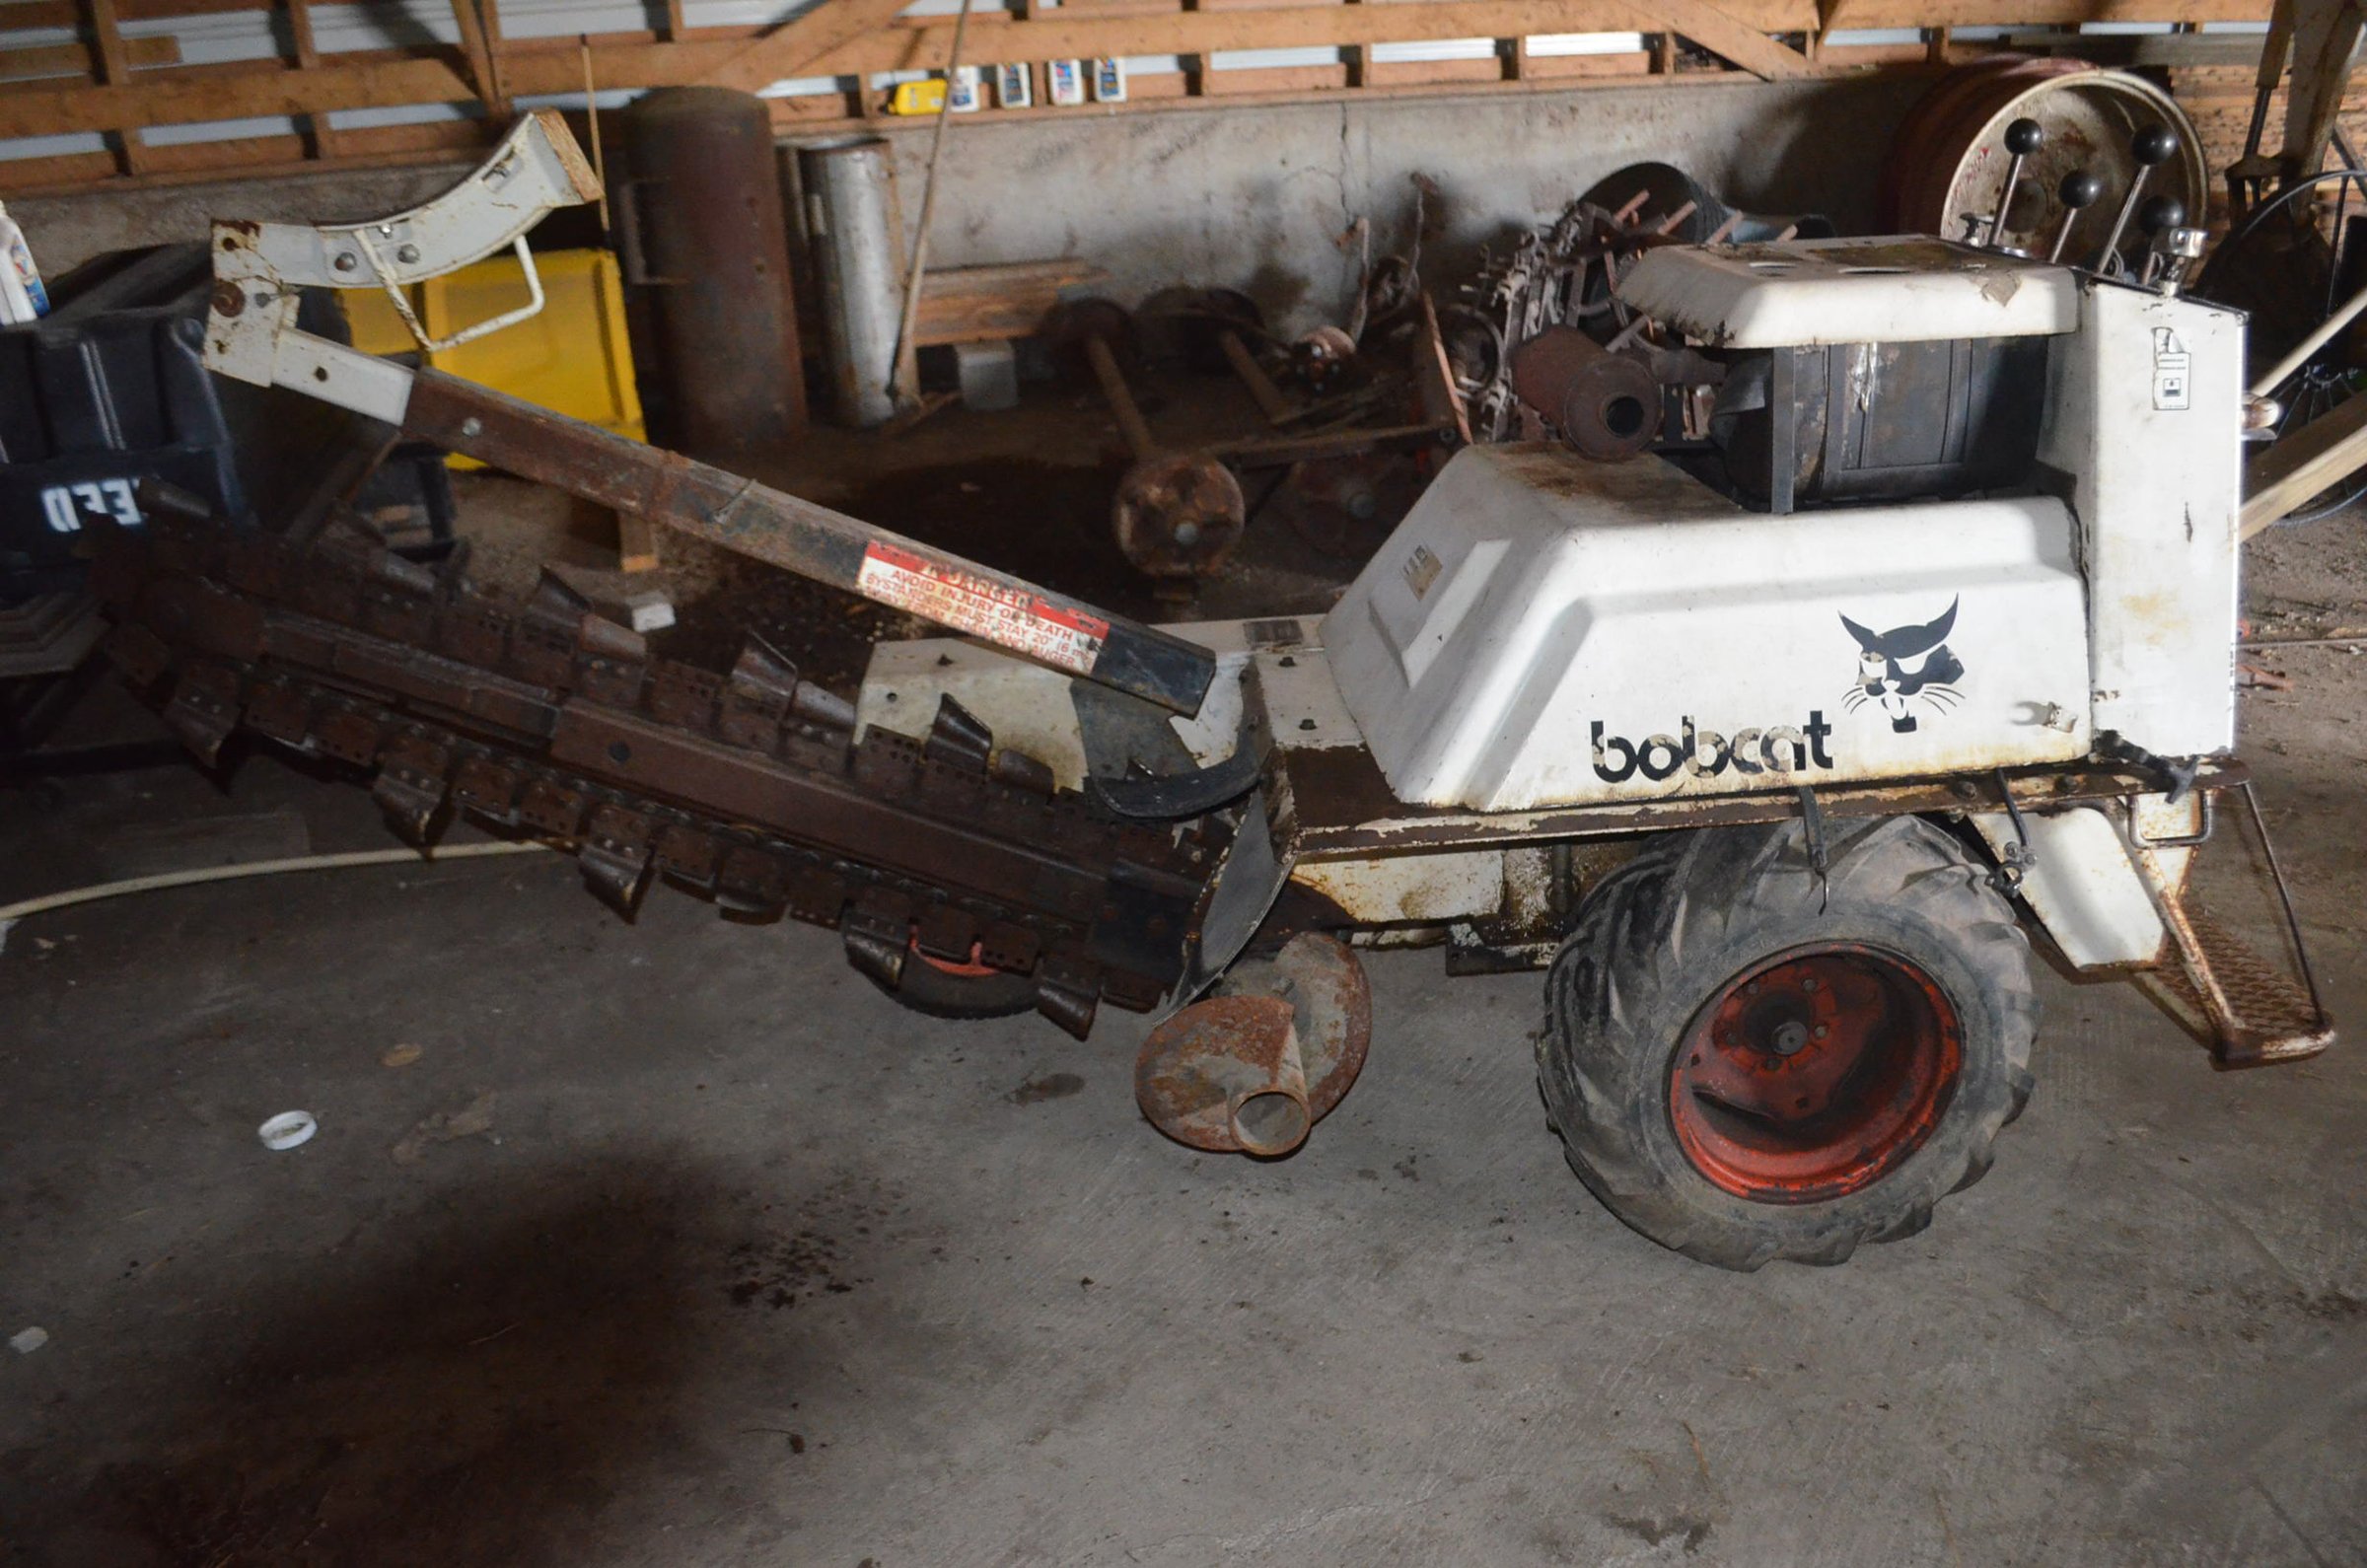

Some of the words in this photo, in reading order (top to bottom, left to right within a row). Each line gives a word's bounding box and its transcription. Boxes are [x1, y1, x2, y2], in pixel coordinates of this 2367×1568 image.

[866, 572, 952, 611] BYSTANDERS
[955, 605, 993, 626] MUST
[995, 619, 1030, 639] STAY
[892, 567, 937, 593] AVOID
[940, 585, 996, 613] INJURY
[999, 606, 1021, 623] OR
[1025, 616, 1073, 642] DEATH
[996, 631, 1027, 651] AND
[1032, 644, 1075, 668] AUGER
[1590, 710, 1833, 783] bobcat
